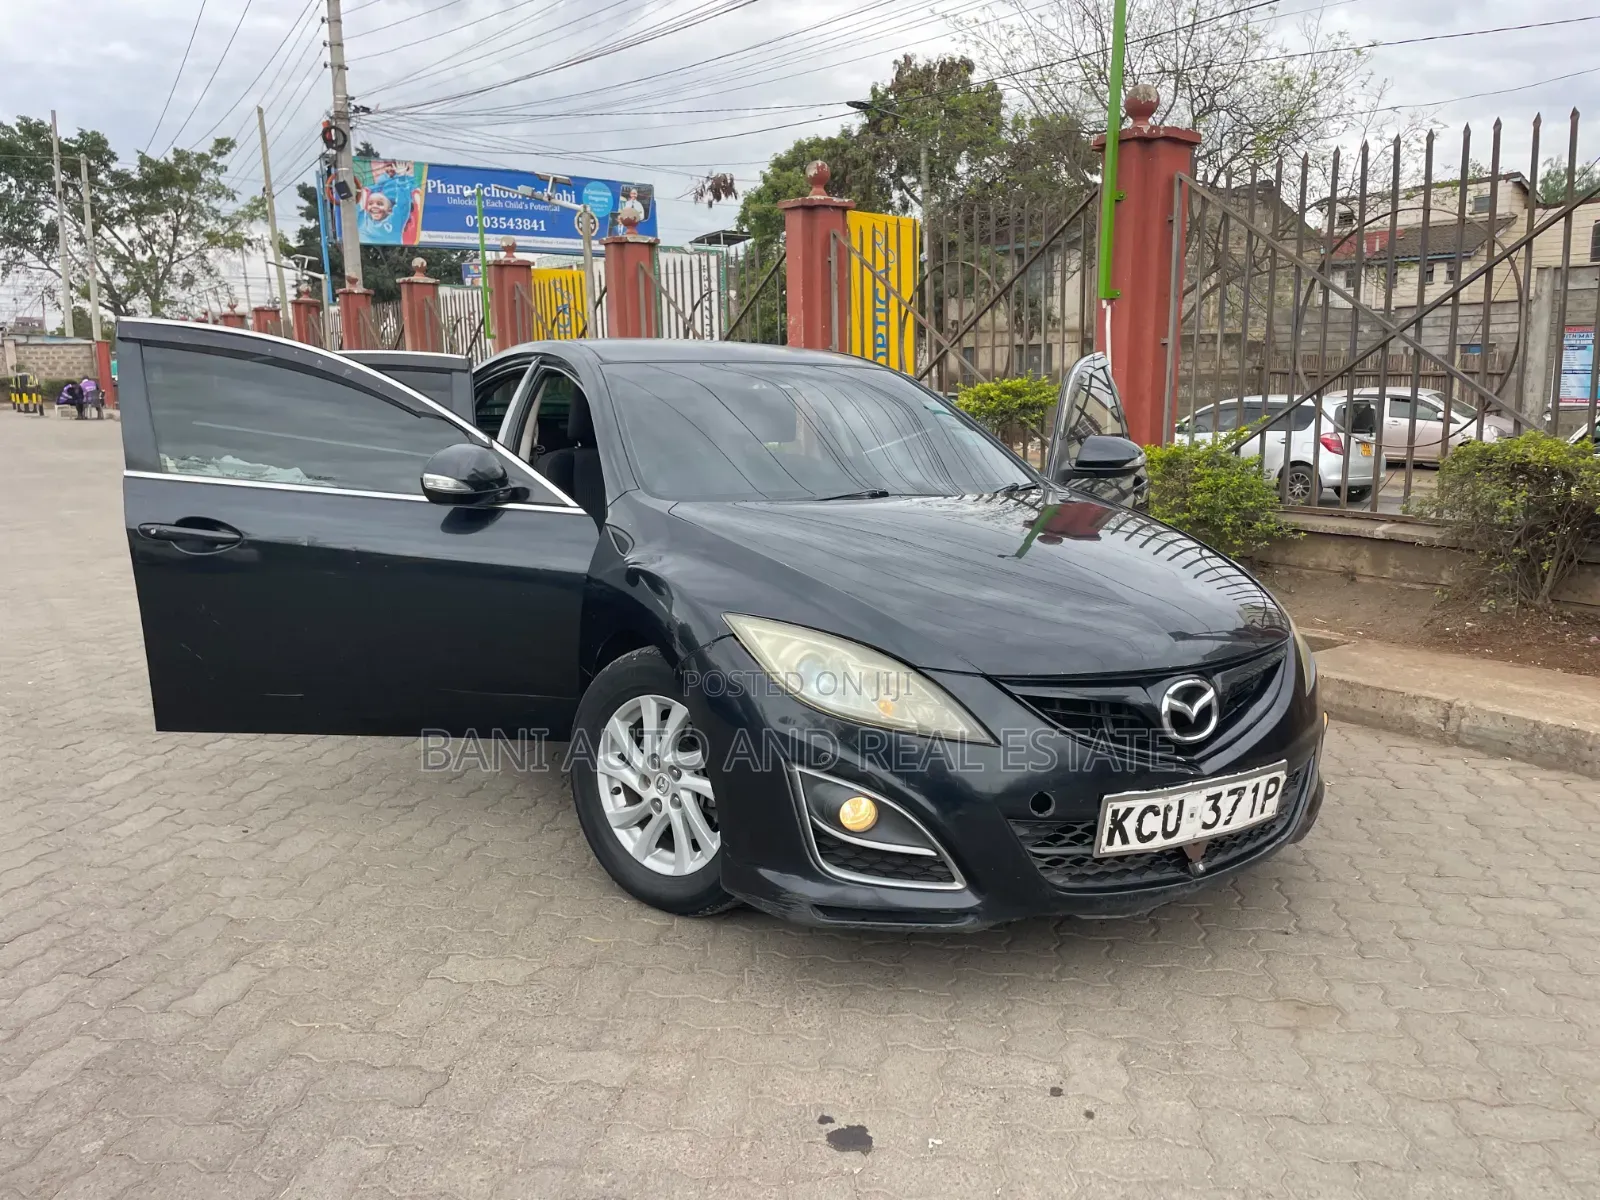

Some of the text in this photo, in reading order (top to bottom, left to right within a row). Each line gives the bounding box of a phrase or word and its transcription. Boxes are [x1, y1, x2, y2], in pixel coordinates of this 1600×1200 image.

[447, 196, 485, 208] Unlocki
[486, 199, 504, 208] Each
[504, 200, 528, 210] Child's
[525, 187, 577, 204] iobi
[465, 214, 547, 232] 0703543841
[1105, 776, 1281, 847] KCU 371P
